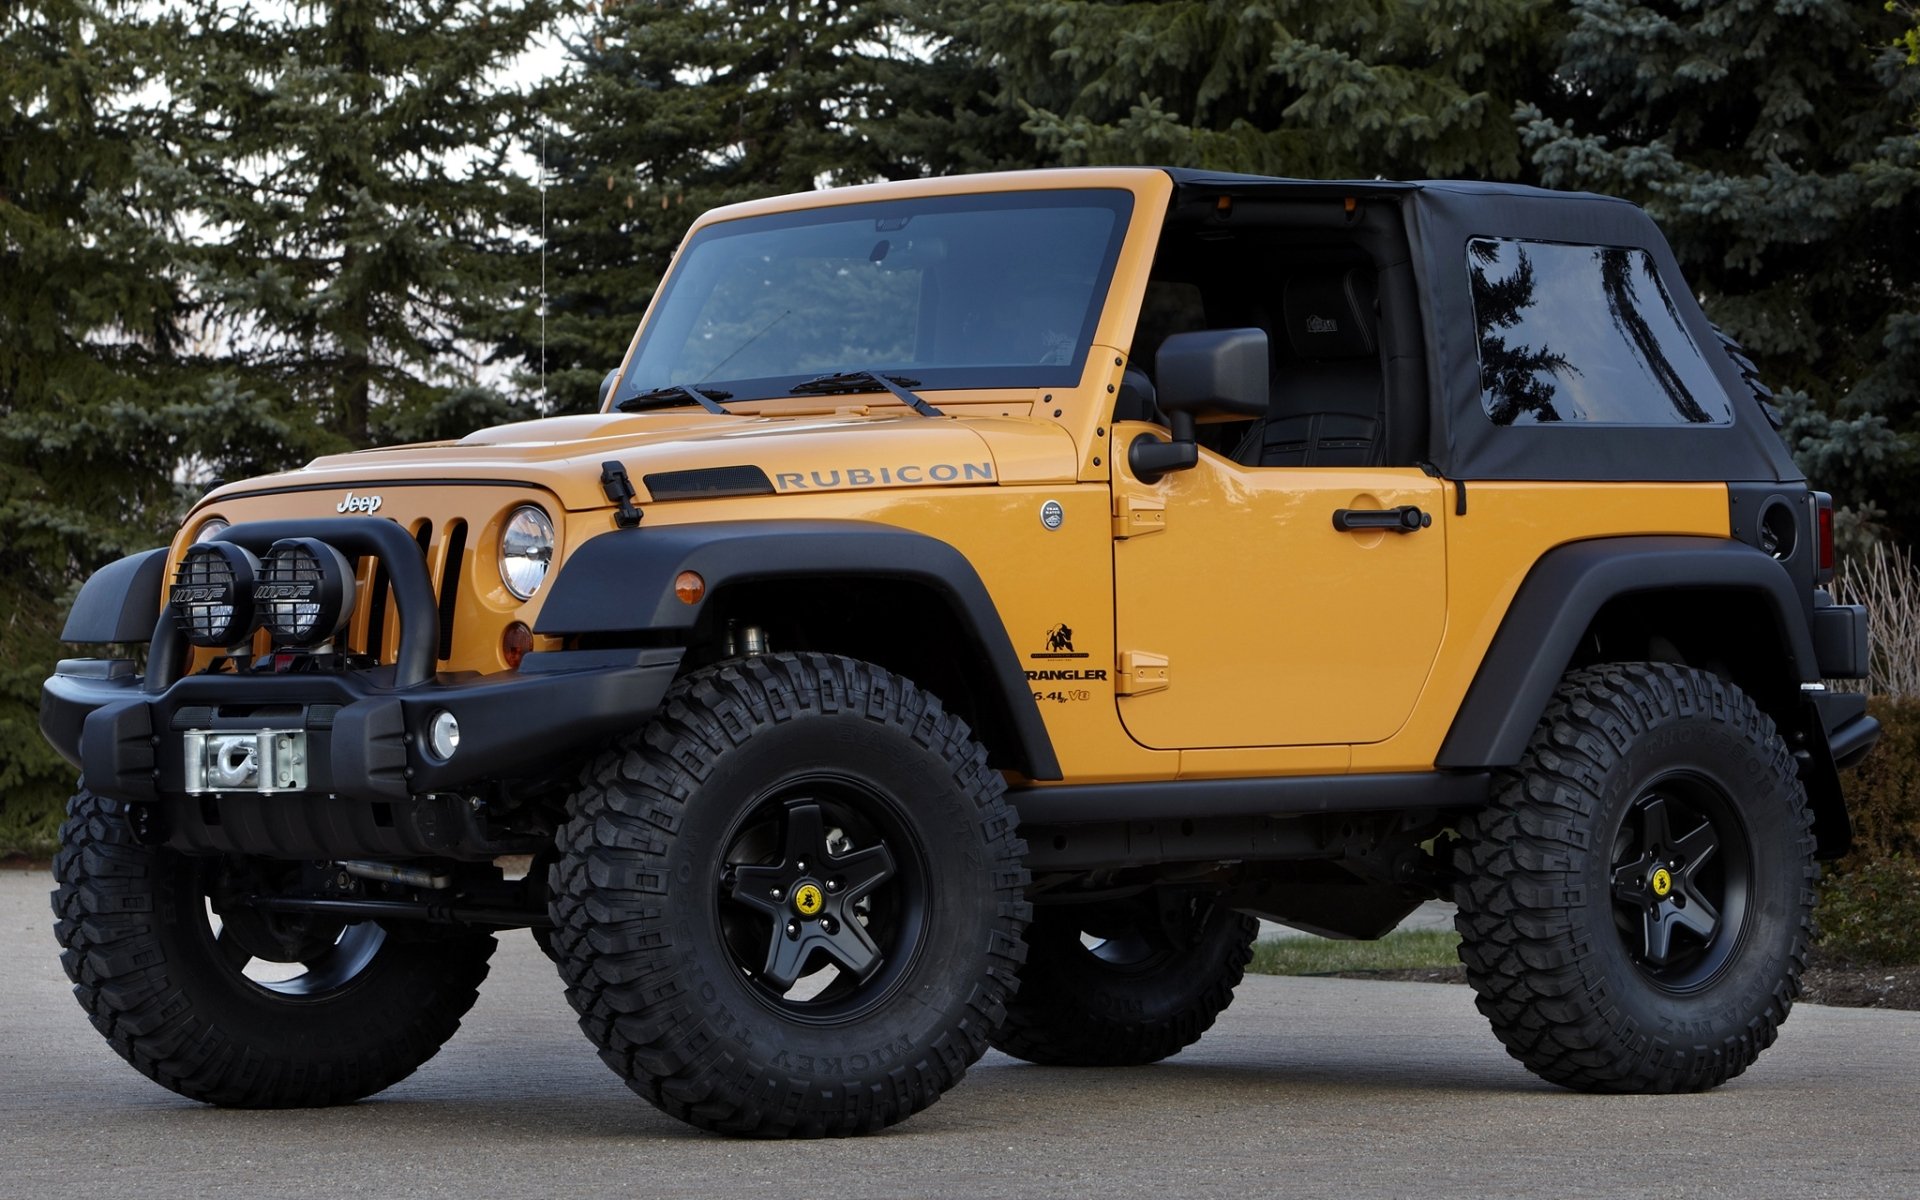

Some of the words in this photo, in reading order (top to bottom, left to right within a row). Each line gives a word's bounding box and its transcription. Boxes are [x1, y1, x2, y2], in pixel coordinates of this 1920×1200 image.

[775, 463, 993, 490] RUBICON
[336, 491, 382, 516] Jeep
[1024, 670, 1107, 681] RANGLER
[1068, 690, 1090, 701] V8
[769, 1033, 916, 1077] MICKEY
